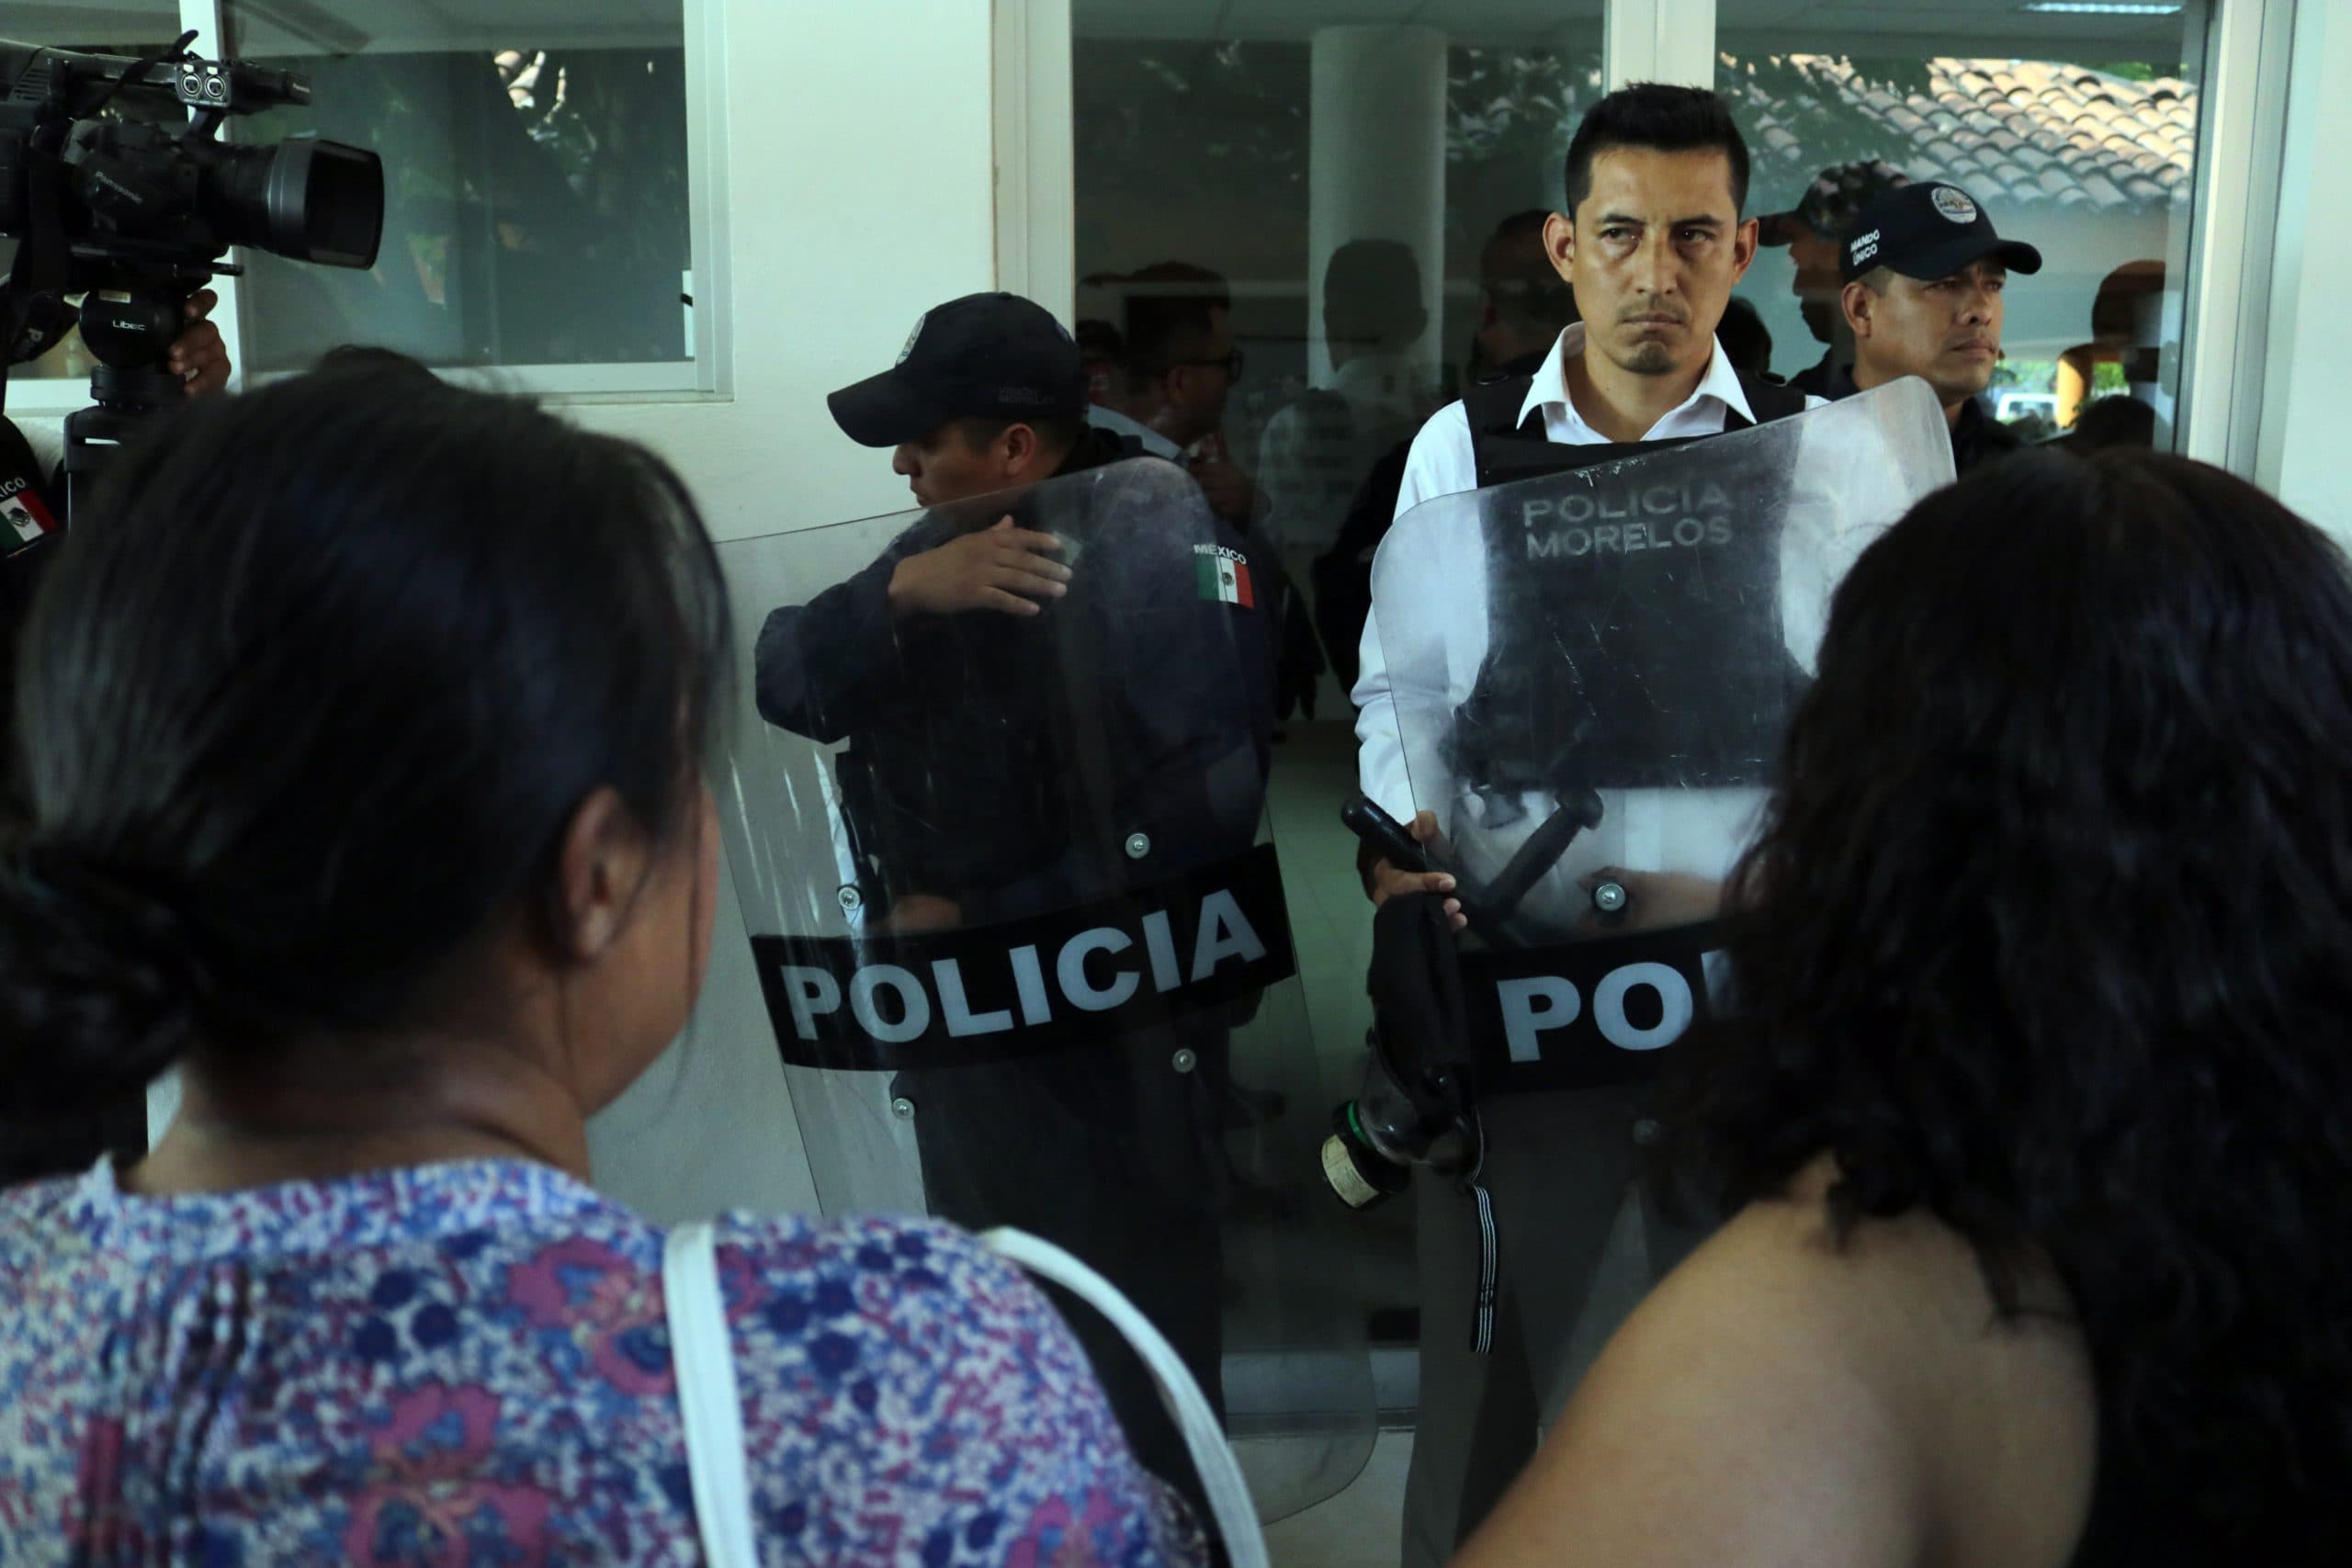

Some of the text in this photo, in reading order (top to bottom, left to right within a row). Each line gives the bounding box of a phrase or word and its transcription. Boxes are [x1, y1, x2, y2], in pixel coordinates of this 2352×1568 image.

[1850, 229, 1880, 254] MANDO
[112, 319, 146, 331] Libec
[1521, 482, 1733, 527] POLICIA
[1525, 514, 1733, 559] MORELOS
[780, 888, 1267, 1043] POLICIA
